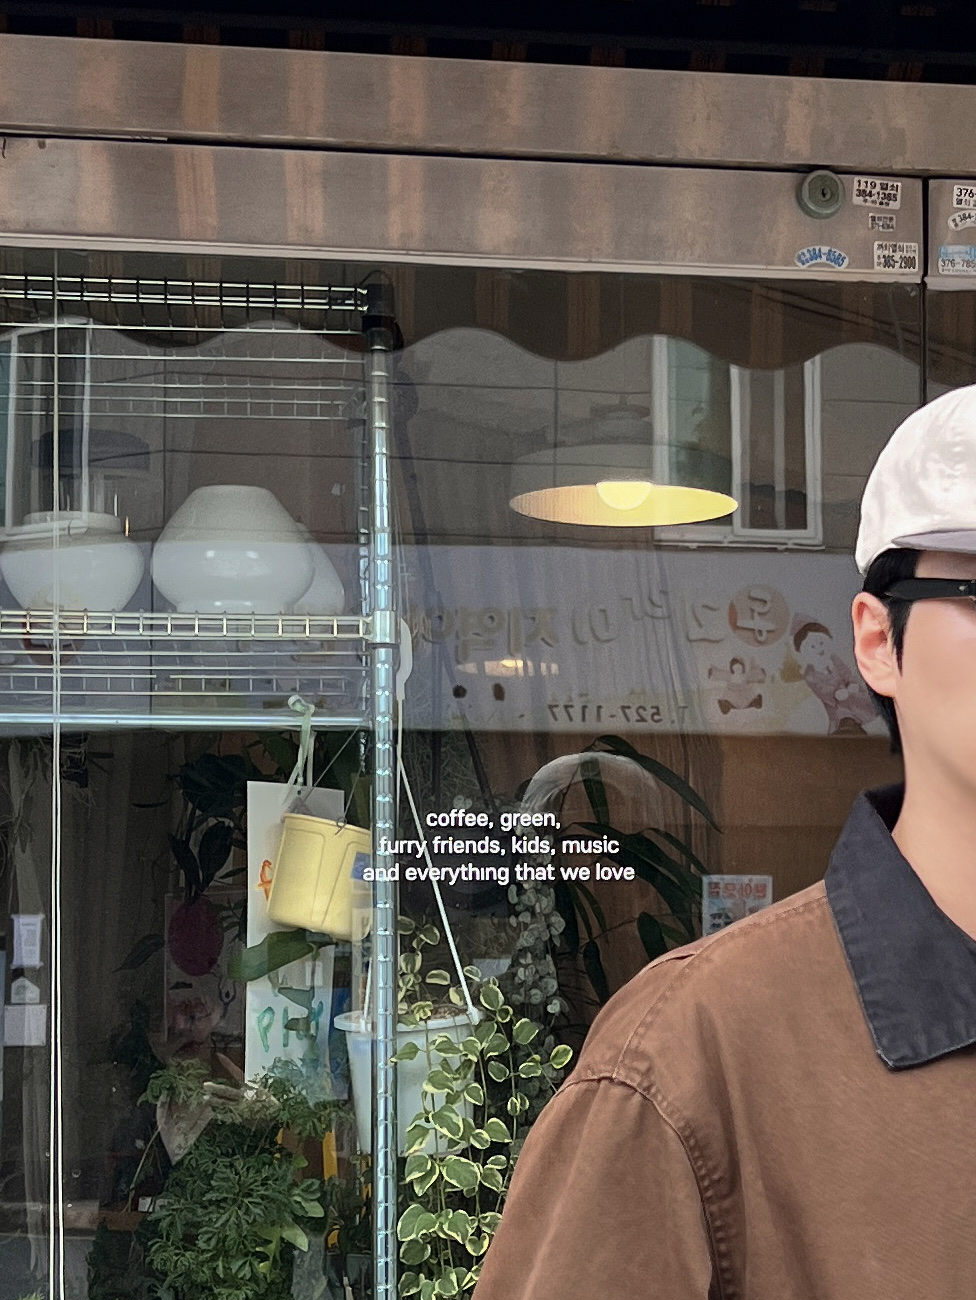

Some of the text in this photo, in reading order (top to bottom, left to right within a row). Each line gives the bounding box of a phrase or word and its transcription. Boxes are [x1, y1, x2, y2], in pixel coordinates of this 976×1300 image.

[425, 808, 561, 832] coffee, green,
[379, 835, 620, 858] furry friends, kids, music
[362, 863, 636, 886] and everything that we love
